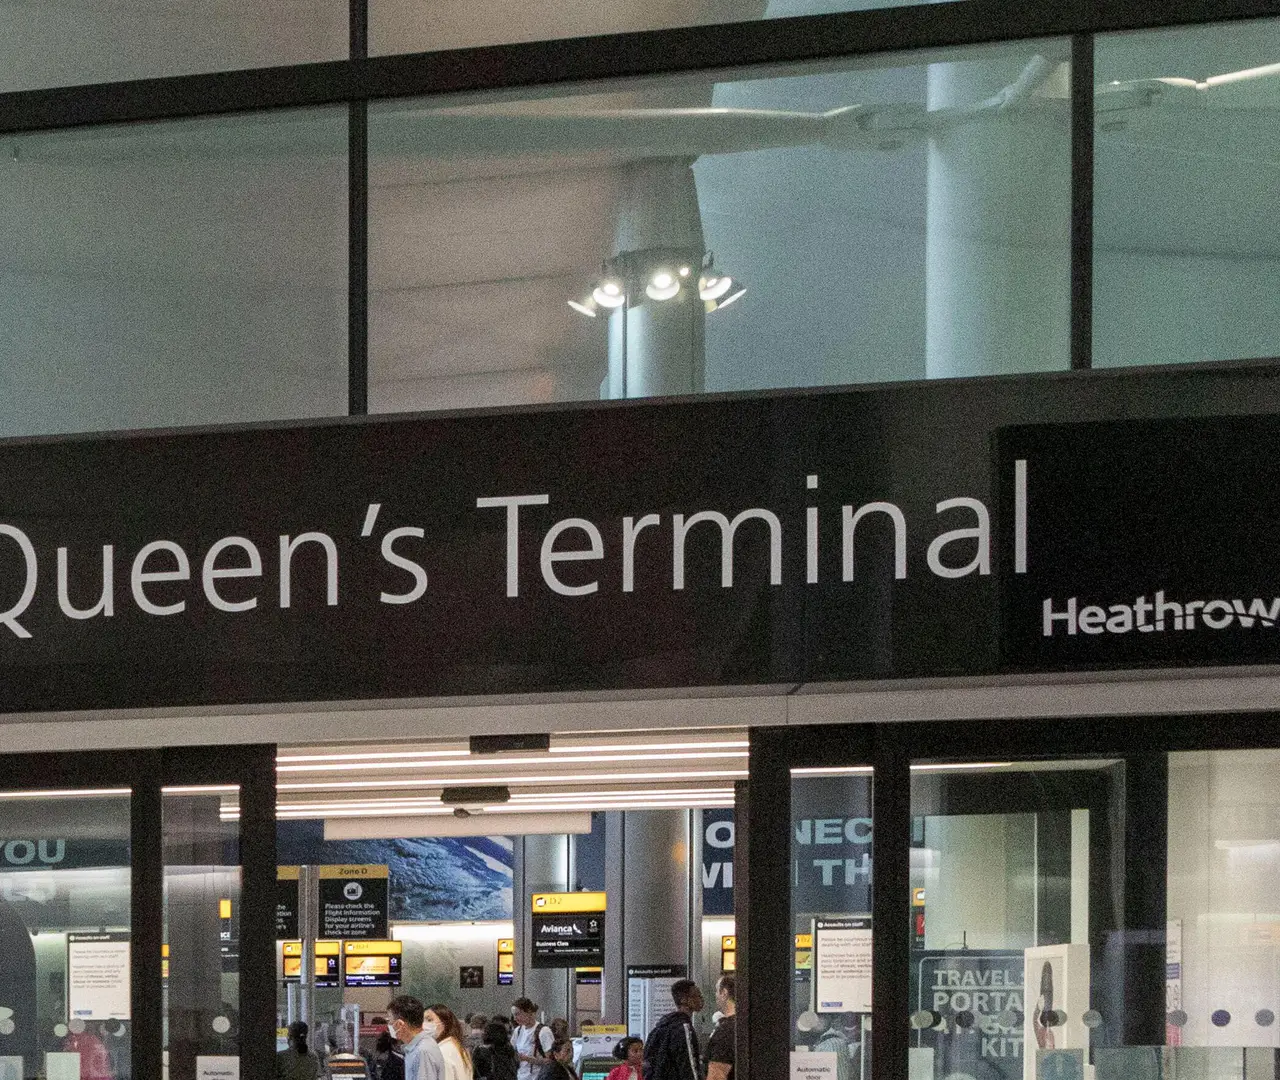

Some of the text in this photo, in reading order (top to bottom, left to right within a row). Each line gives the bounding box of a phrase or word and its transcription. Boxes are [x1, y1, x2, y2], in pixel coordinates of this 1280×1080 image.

[476, 460, 1028, 598] Terminal
[1042, 590, 1280, 637] Heathrow
[541, 924, 572, 933] Avianca
[933, 970, 1015, 986] TRAVEL
[933, 991, 1024, 1012] PORTA
[981, 1038, 1023, 1058] KIT
